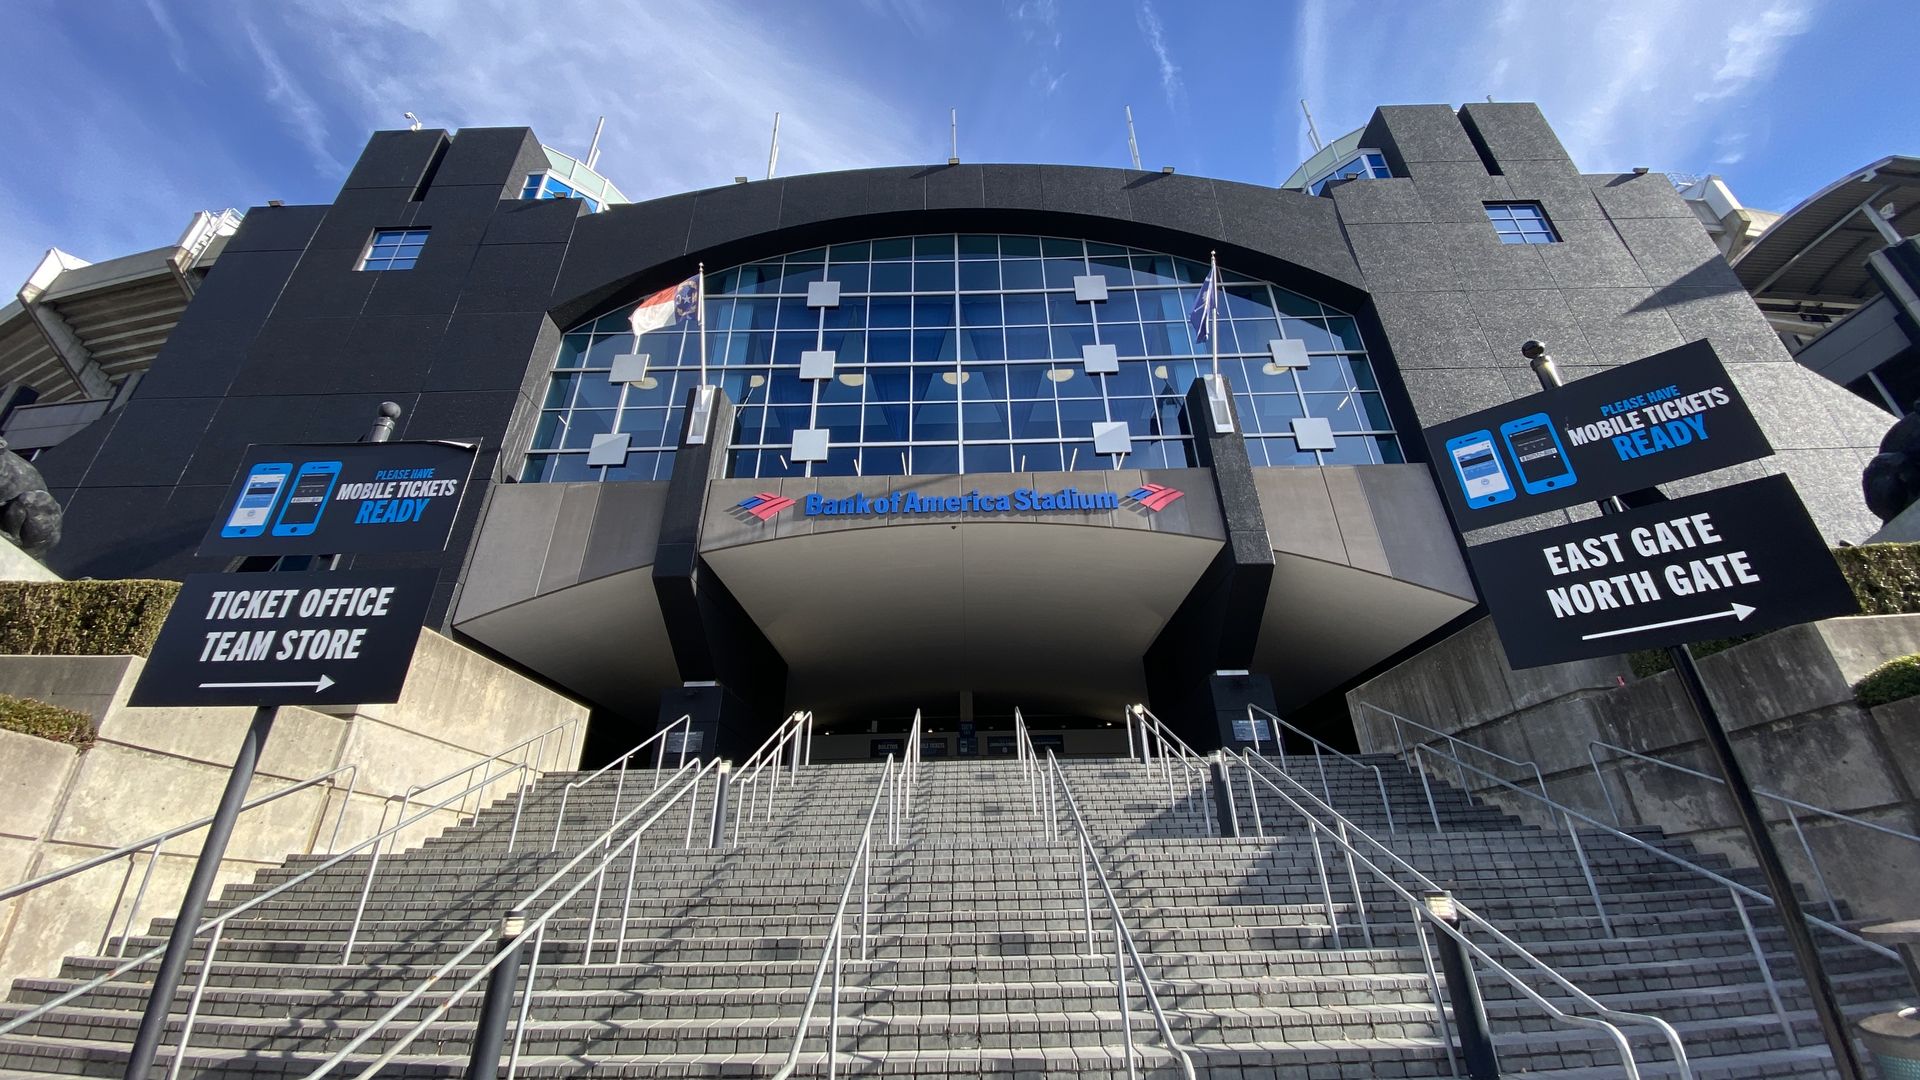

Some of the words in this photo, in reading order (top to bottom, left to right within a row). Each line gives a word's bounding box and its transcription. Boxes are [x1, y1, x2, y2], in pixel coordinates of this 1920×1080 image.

[1566, 411, 1645, 447] MOBILE
[1641, 386, 1730, 425] TICKETS
[1600, 394, 1648, 417] PLEASE
[1646, 384, 1681, 404] HAVE
[1611, 412, 1709, 462] READY
[335, 482, 397, 501] MOBILE
[396, 479, 459, 498] TICKETS
[375, 470, 412, 481] PLEASE
[409, 467, 435, 480] HAVE
[354, 498, 431, 525] READY
[804, 490, 873, 516] Bank
[873, 490, 902, 514] of
[902, 488, 1011, 514] America
[1013, 486, 1119, 511] Stadium
[1542, 533, 1625, 576] EAST
[1630, 512, 1723, 557] GATE
[1545, 570, 1662, 619] NORTH
[1664, 550, 1761, 597] GATE
[205, 589, 300, 620] TICKET
[299, 586, 396, 618] OFFICE
[199, 630, 277, 662] TEAM
[276, 628, 368, 661] STORE
